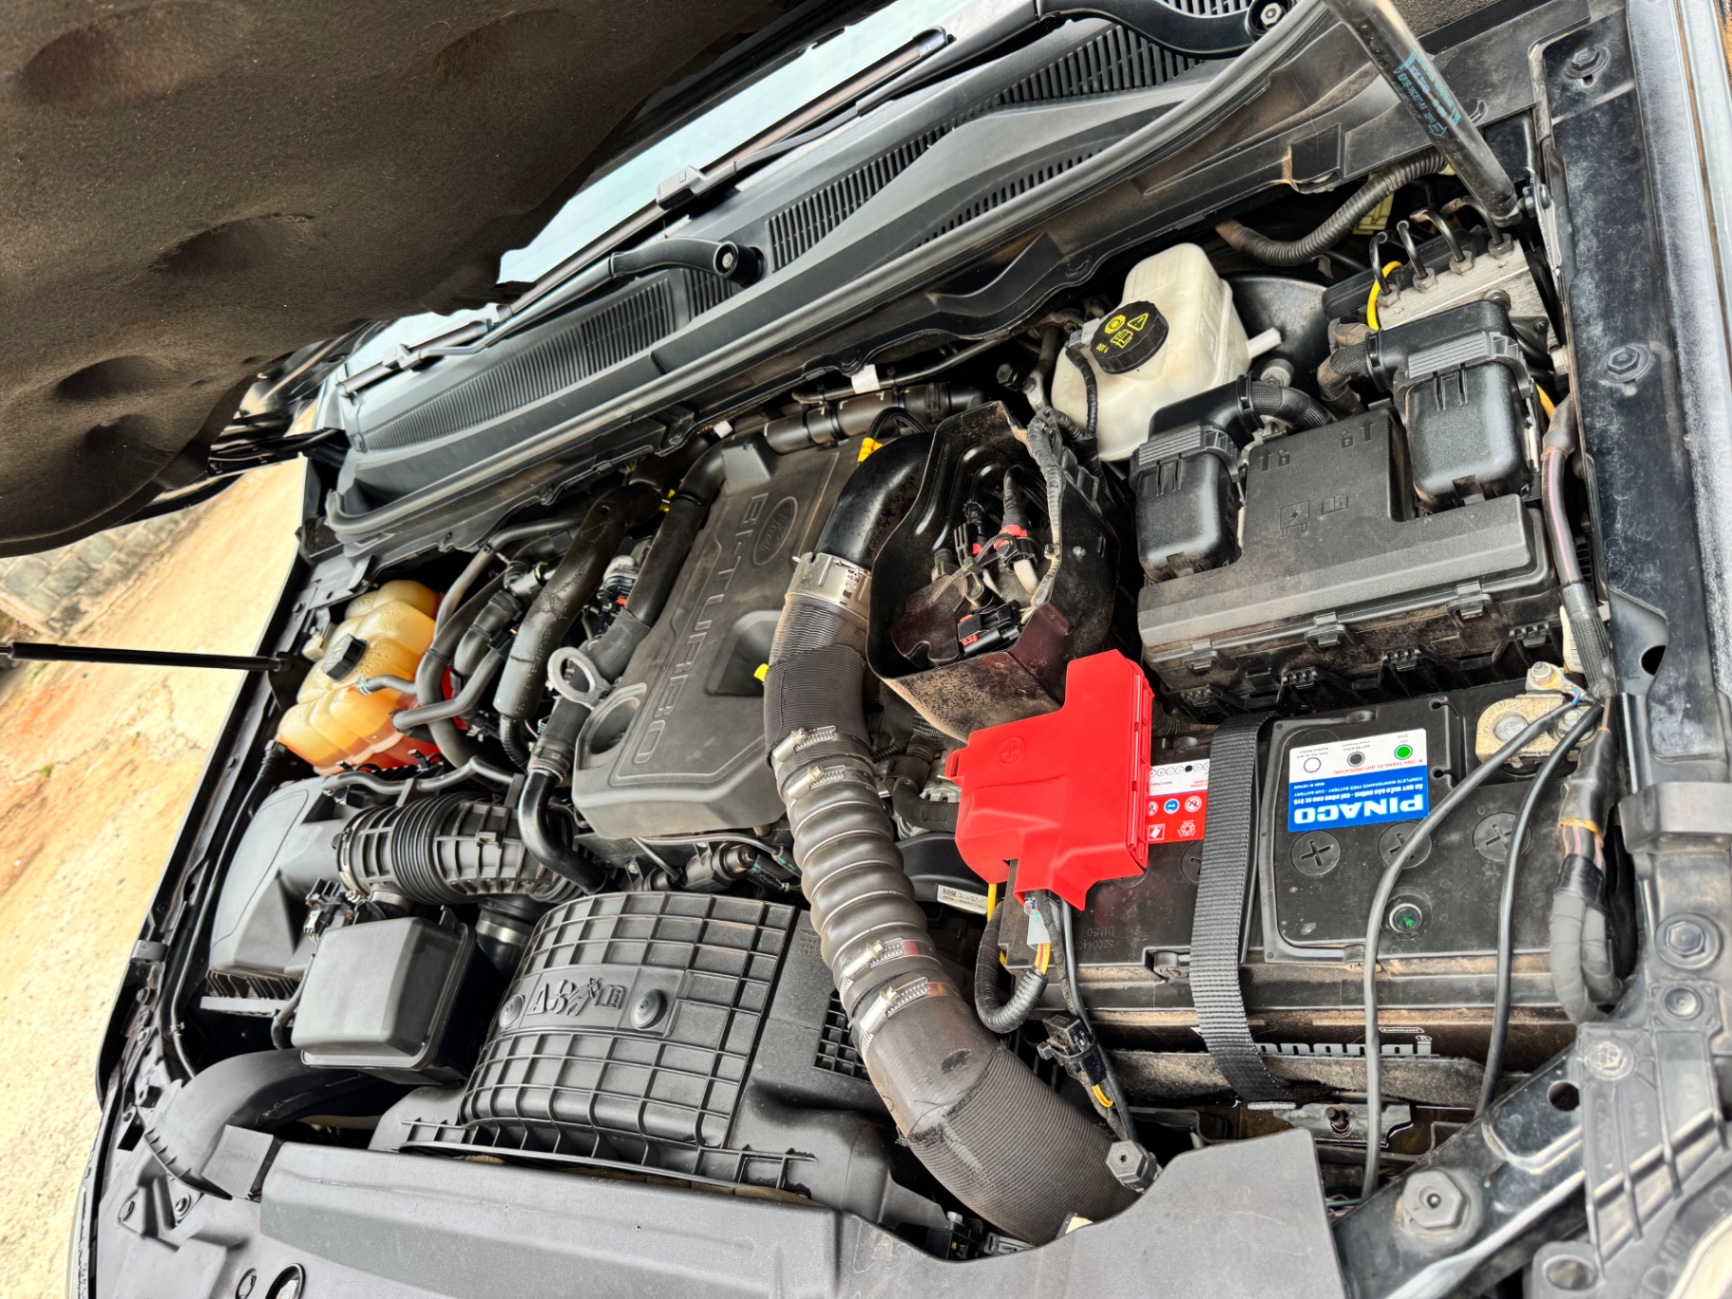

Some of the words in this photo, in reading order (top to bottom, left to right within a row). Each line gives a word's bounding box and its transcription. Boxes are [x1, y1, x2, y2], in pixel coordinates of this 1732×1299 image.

[632, 492, 769, 766] BI-TURBO
[1363, 780, 1396, 789] MAINTENANCE
[1294, 794, 1424, 824] PINACO
